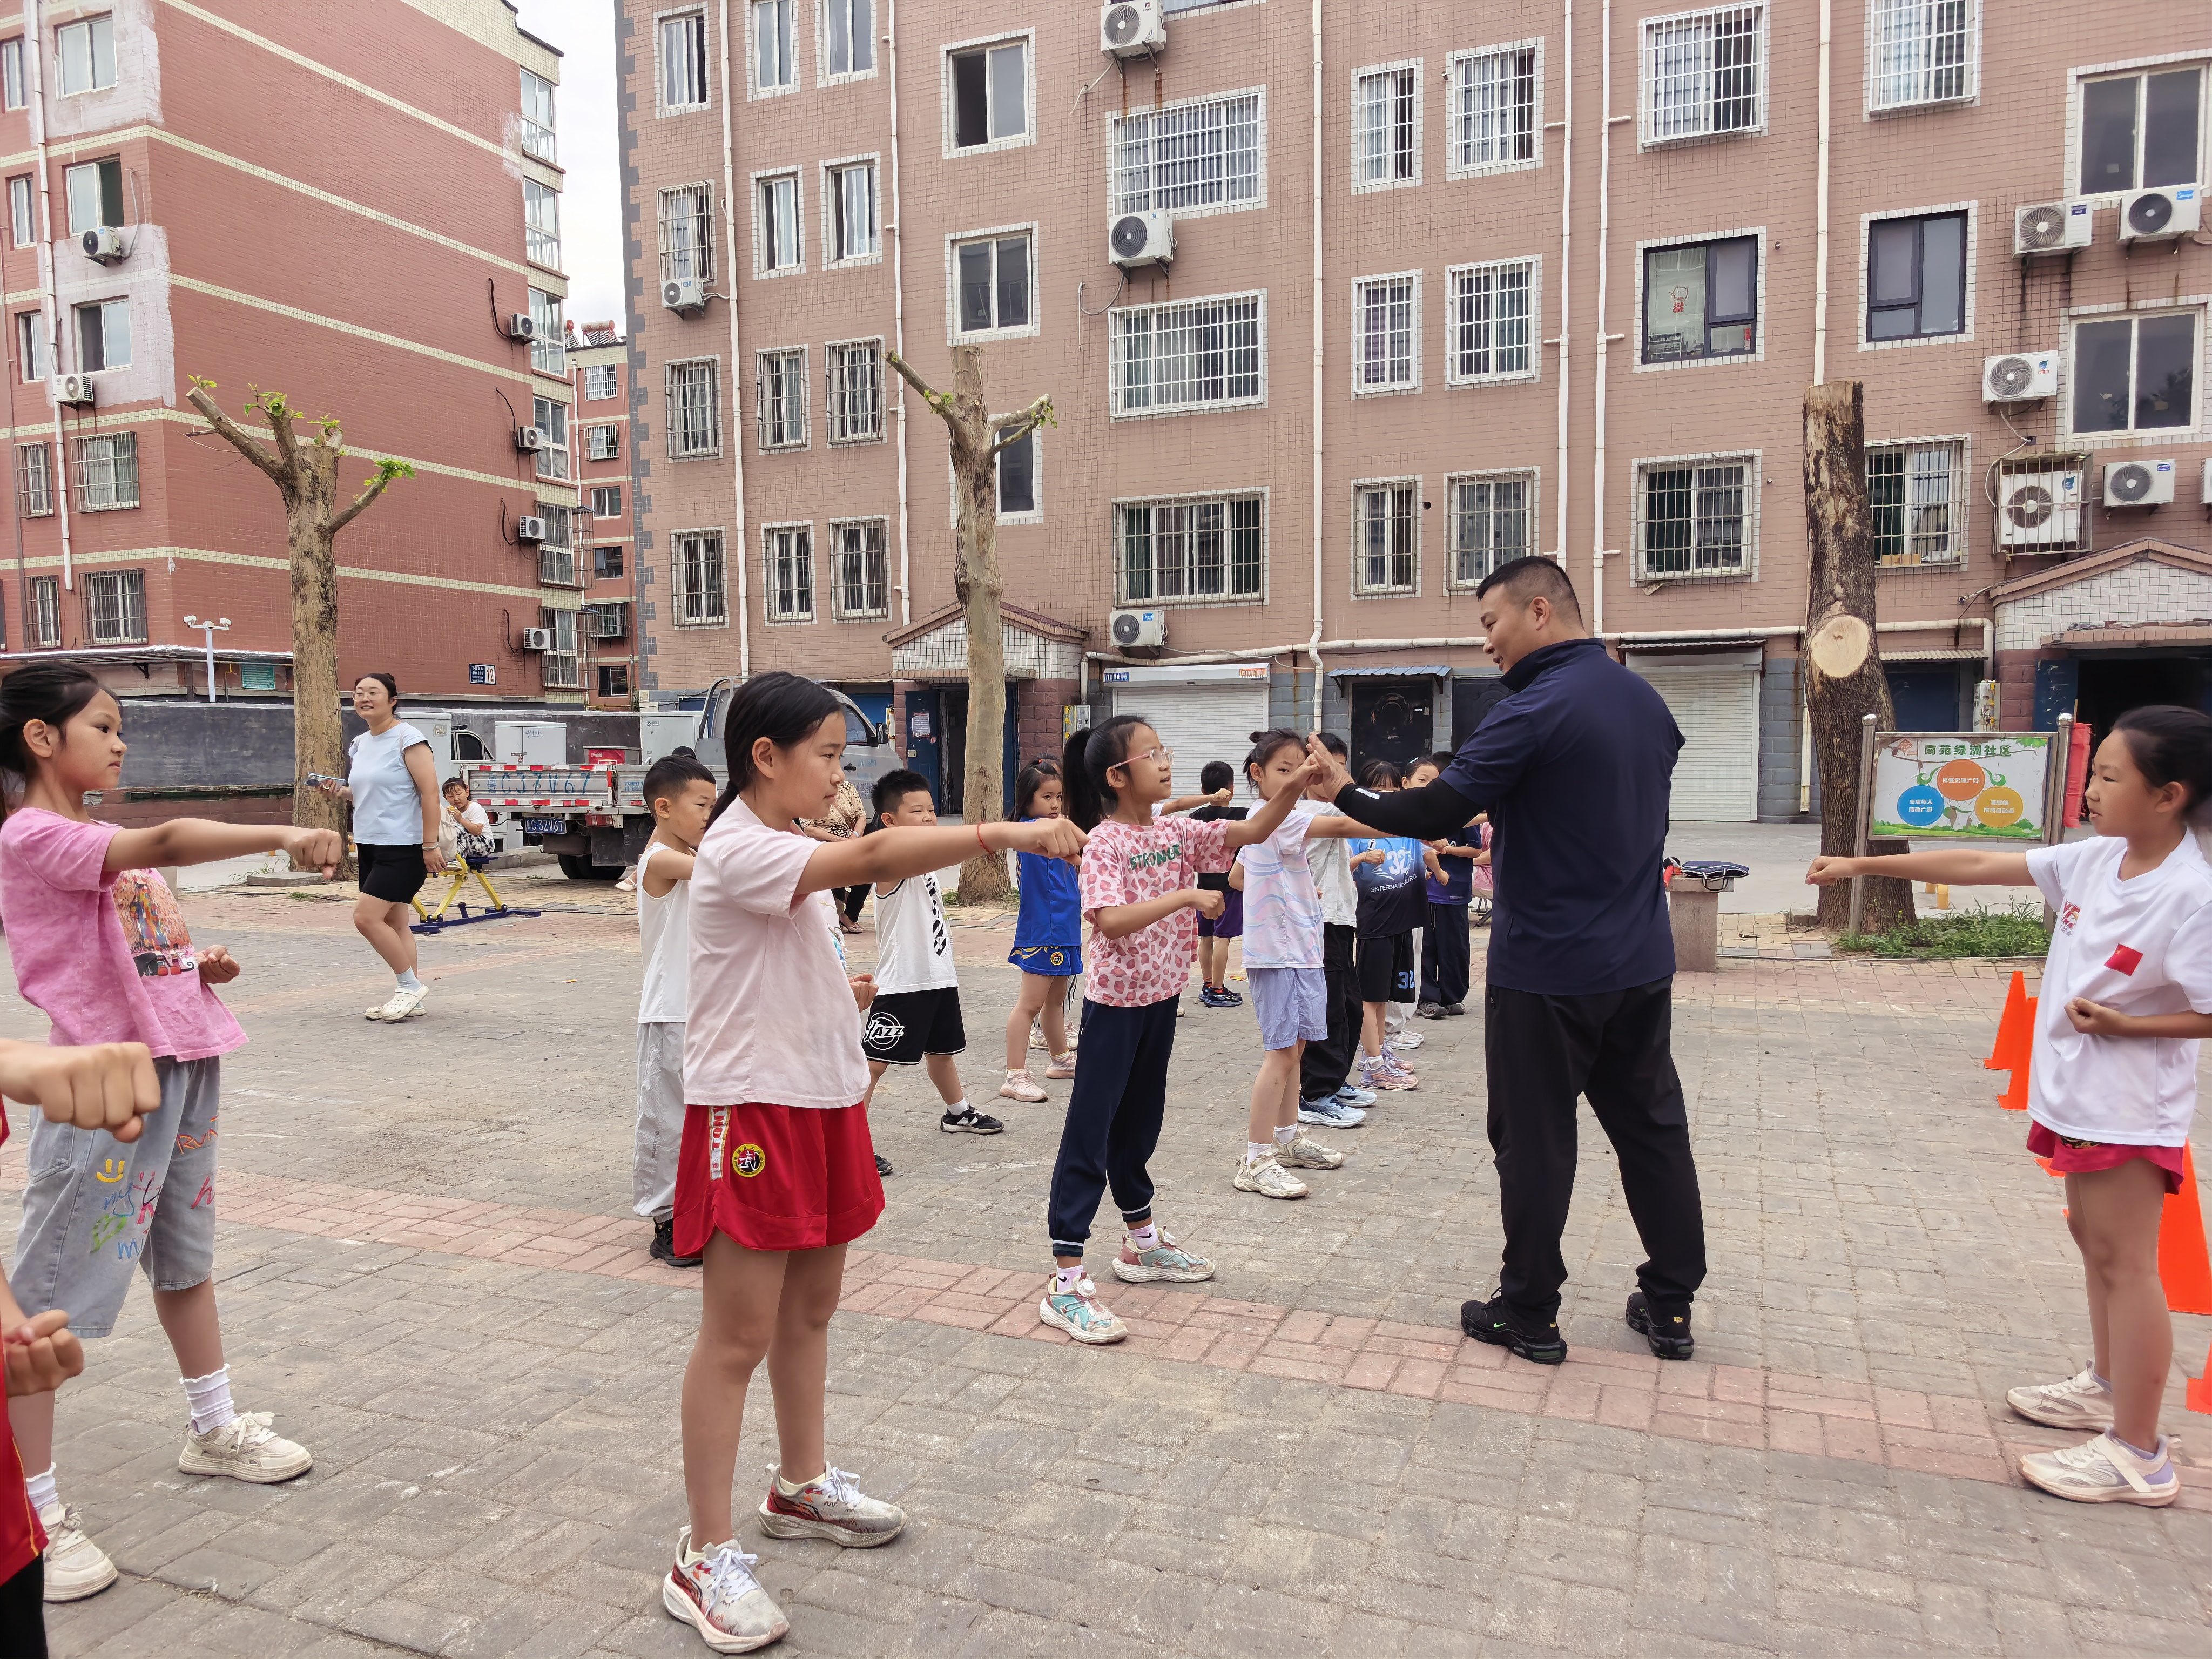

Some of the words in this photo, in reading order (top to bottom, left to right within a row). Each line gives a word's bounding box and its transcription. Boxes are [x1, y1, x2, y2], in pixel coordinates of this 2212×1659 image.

[487, 667, 494, 682] 12
[1924, 745, 2012, 757] 南苑绿洲社区
[1398, 970, 1415, 989] 32
[864, 1019, 905, 1042] JAZZ
